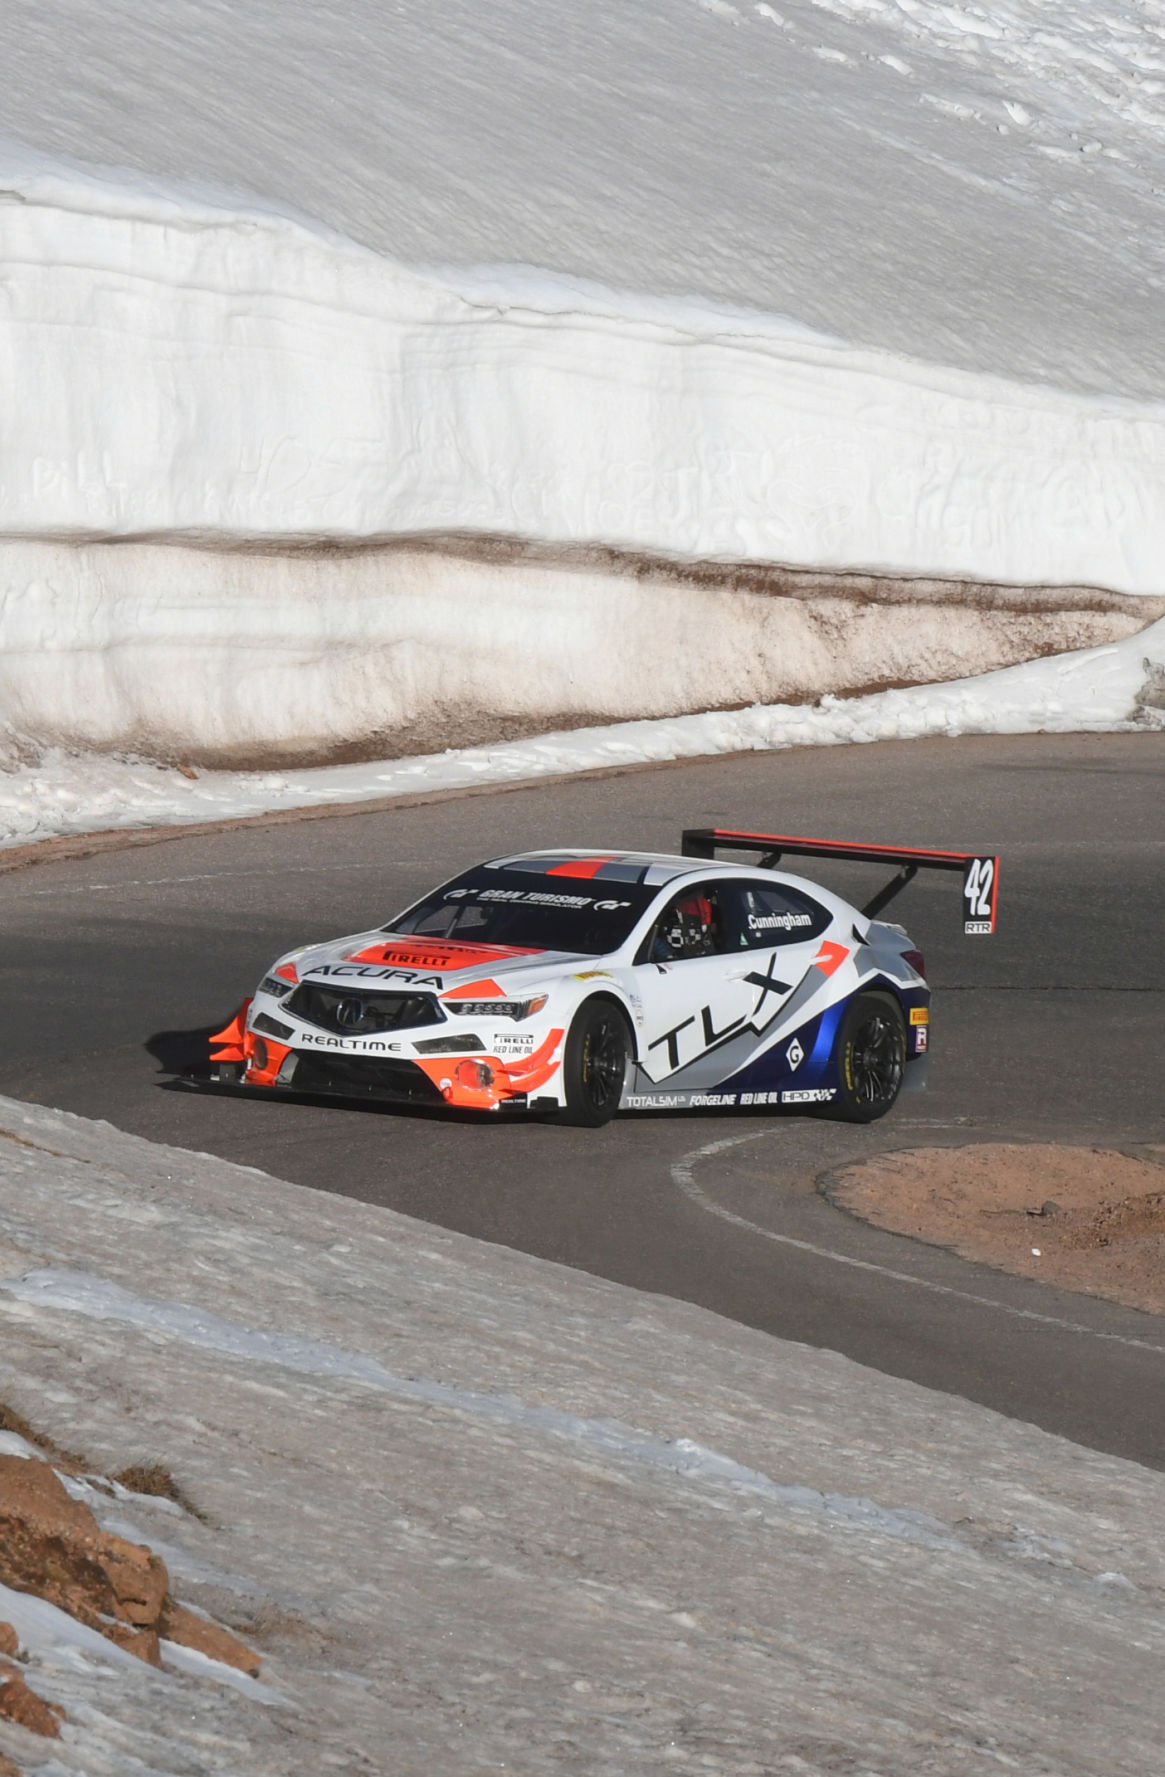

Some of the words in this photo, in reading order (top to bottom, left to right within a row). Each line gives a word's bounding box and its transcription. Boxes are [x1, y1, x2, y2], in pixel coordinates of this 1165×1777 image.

[964, 858, 993, 916] 42
[479, 889, 525, 899] GRAN
[522, 891, 592, 906] TURISMO
[748, 911, 812, 931] Cunningham
[966, 923, 990, 932] RTR
[382, 951, 451, 966] PIRELLI
[302, 965, 443, 990] ACURA
[648, 952, 793, 1070] TLX
[301, 1033, 402, 1051] REALTIME
[508, 1046, 523, 1054] LINE
[789, 1045, 800, 1064] G
[626, 1095, 678, 1107] TOTALSIM
[689, 1094, 737, 1106] FORGELINE
[783, 1091, 810, 1101] HPD
